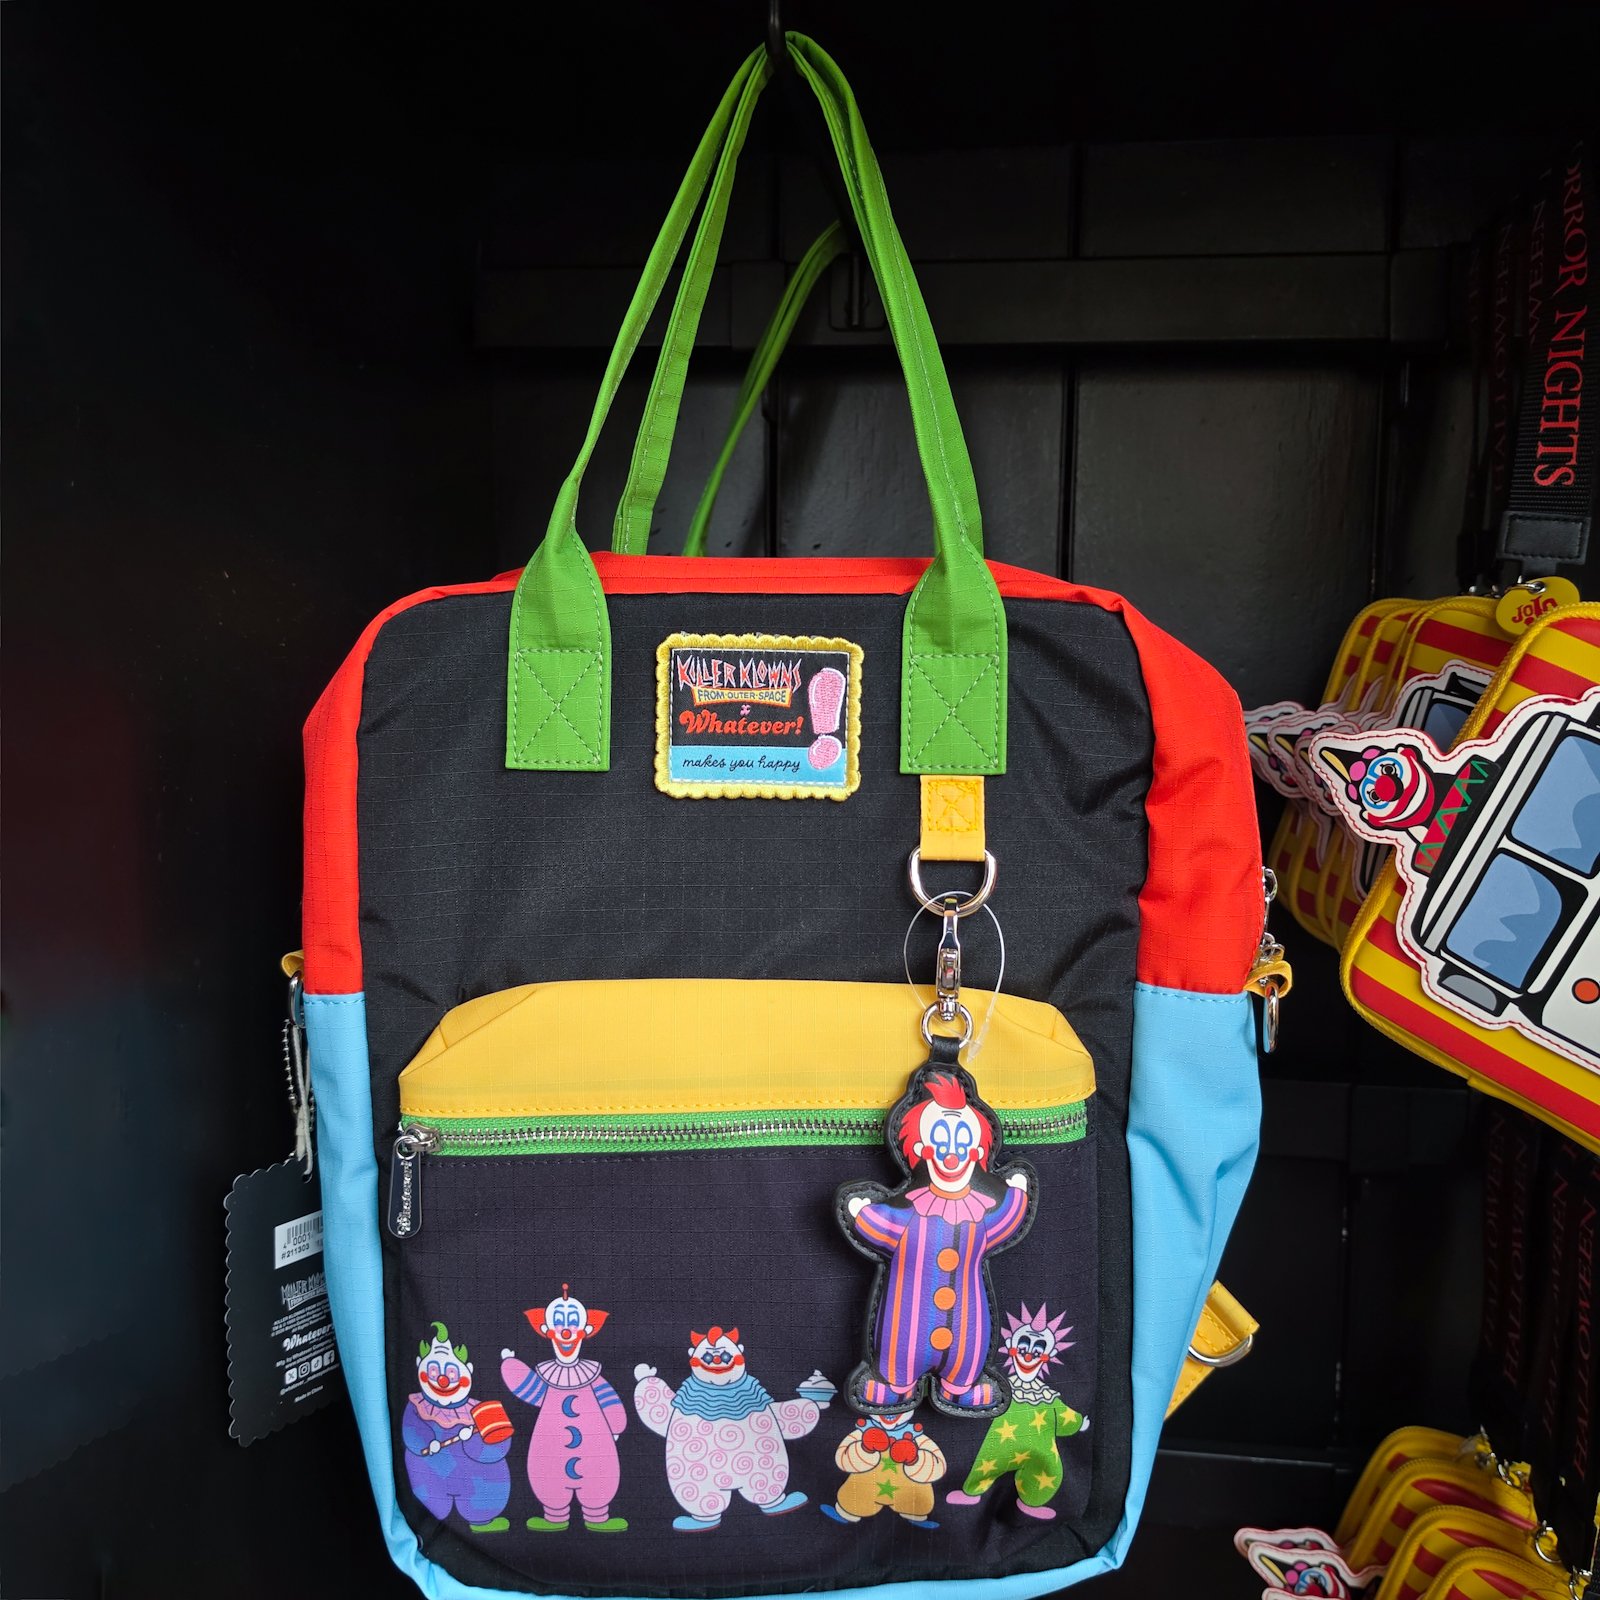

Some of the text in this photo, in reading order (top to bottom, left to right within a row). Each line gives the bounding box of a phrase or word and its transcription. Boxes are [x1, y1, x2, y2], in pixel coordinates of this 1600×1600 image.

[1533, 304, 1589, 487] NIGHTS
[676, 654, 802, 693] KILLER KLOWNS
[697, 688, 786, 703] FROM OUTER SPACE
[679, 709, 804, 735] Whatever!
[682, 755, 801, 772] makes you happy
[1573, 1197, 1598, 1481] HALLOWEEN
